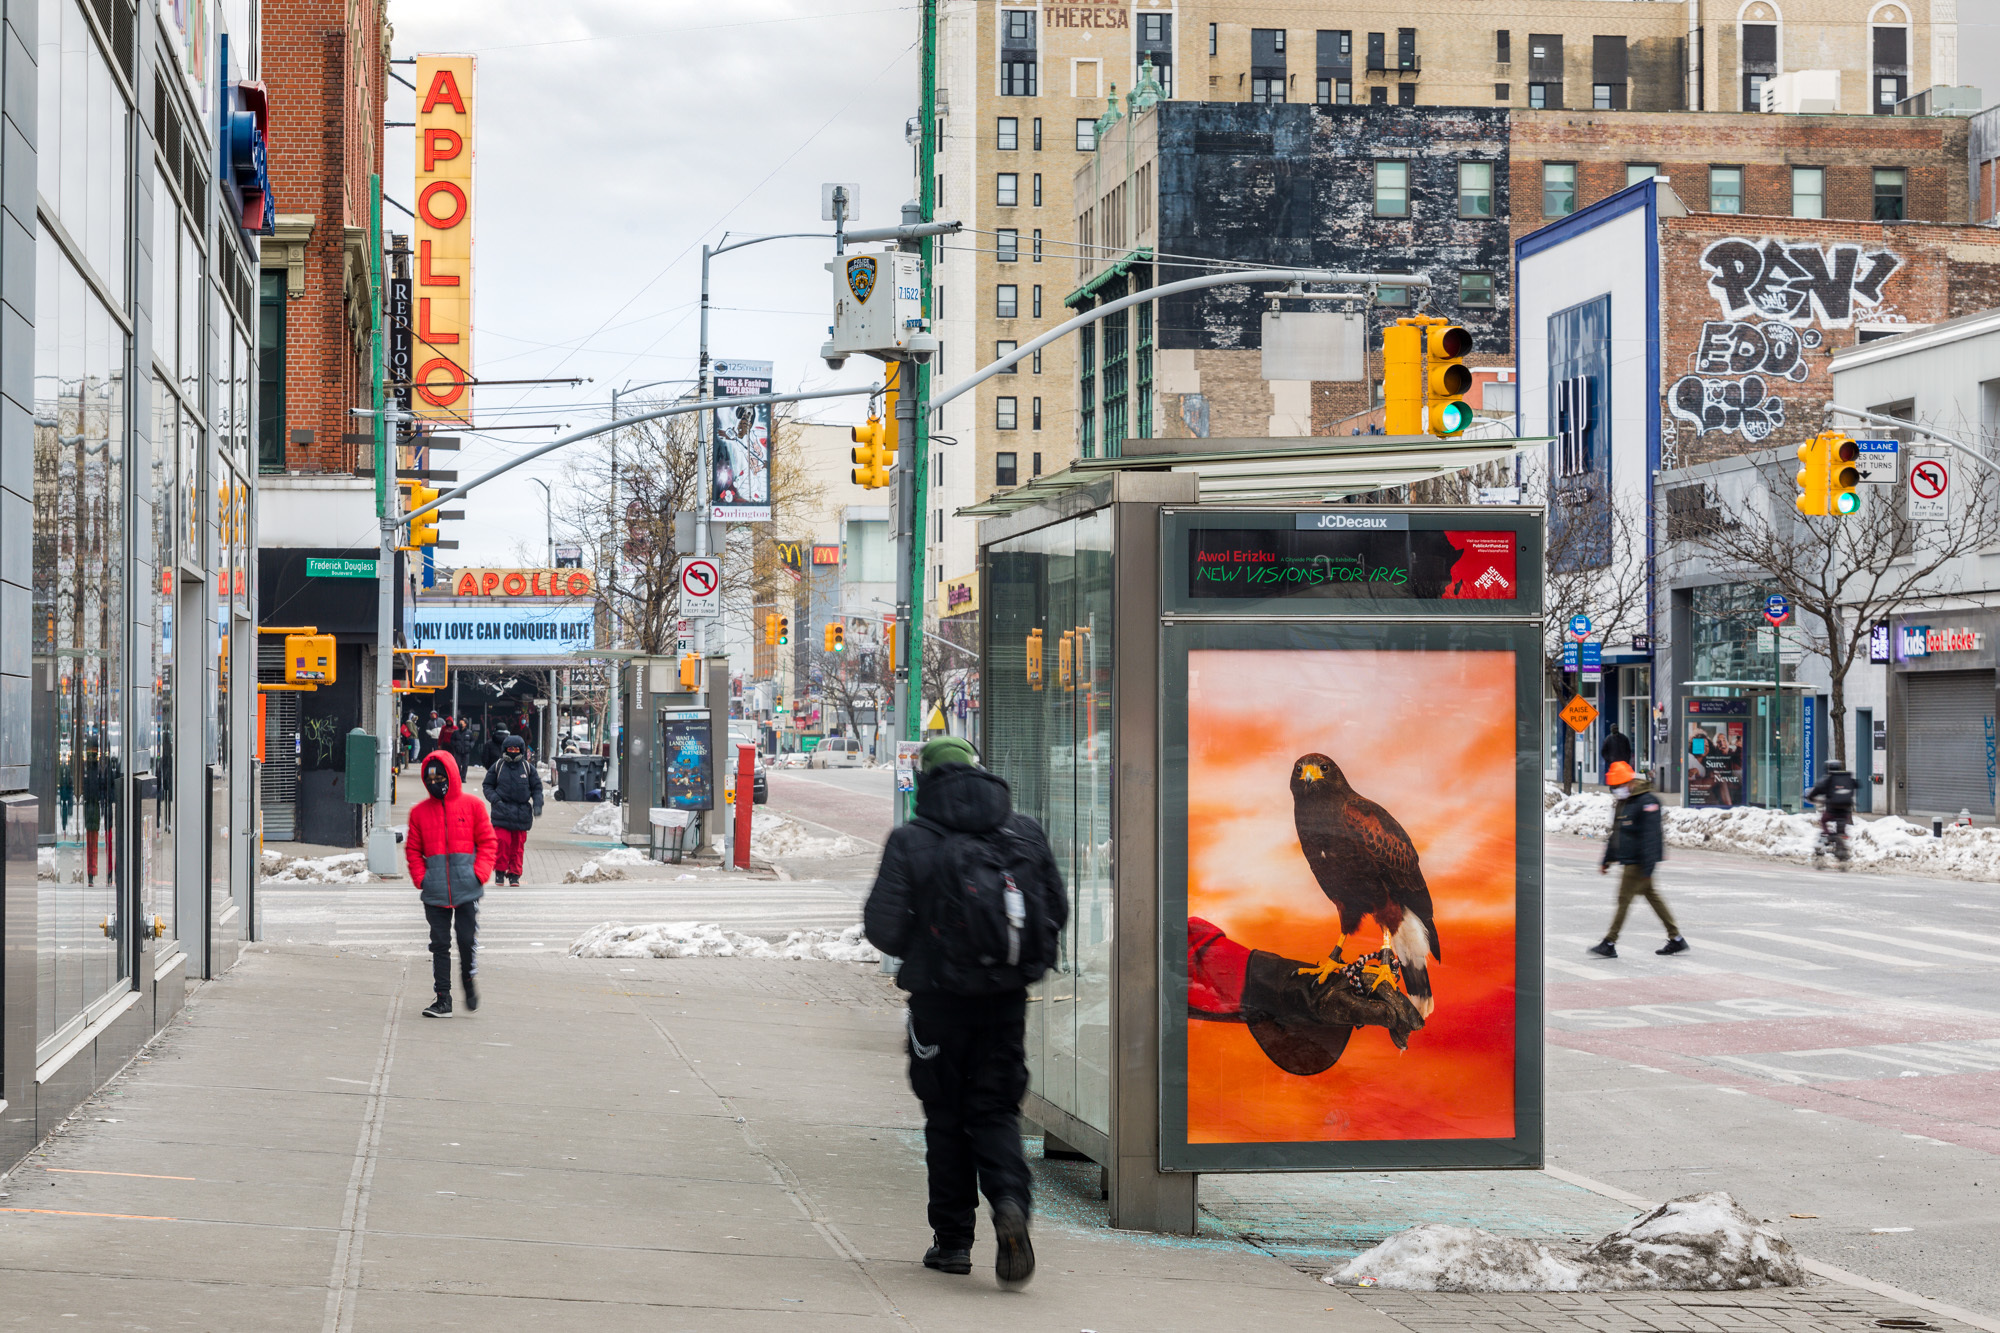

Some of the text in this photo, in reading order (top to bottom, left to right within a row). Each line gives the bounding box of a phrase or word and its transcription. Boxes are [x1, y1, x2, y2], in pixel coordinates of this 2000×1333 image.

[1043, 7, 1129, 29] THERESA
[416, 70, 467, 407] APOLLO
[848, 263, 875, 273] DEPARTMENT
[394, 284, 408, 329] RED
[906, 319, 923, 328] NYPD
[718, 378, 769, 388] Music & Fashion
[726, 386, 760, 395] EXPLOSION
[1556, 374, 1588, 479] GAP
[714, 507, 768, 519] Burlington
[1317, 515, 1388, 528] JCDecaux
[1197, 550, 1275, 562] Awol Erizku
[310, 560, 374, 573] Frederick Douglass
[1197, 565, 1408, 585] NEW VISIONS FOR IRIS
[458, 572, 590, 596] APOLLO
[1473, 565, 1496, 588] PUBLIC
[1482, 570, 1510, 590] ART FUND
[414, 622, 590, 641] ONLY LOVE CAN CONQUER HATE
[1904, 627, 1976, 656] kids Foot Locker
[636, 665, 644, 710] Newsstand
[1705, 760, 1726, 768] Sure.
[1803, 759, 1811, 787] Douglass
[1714, 774, 1740, 783] Never.
